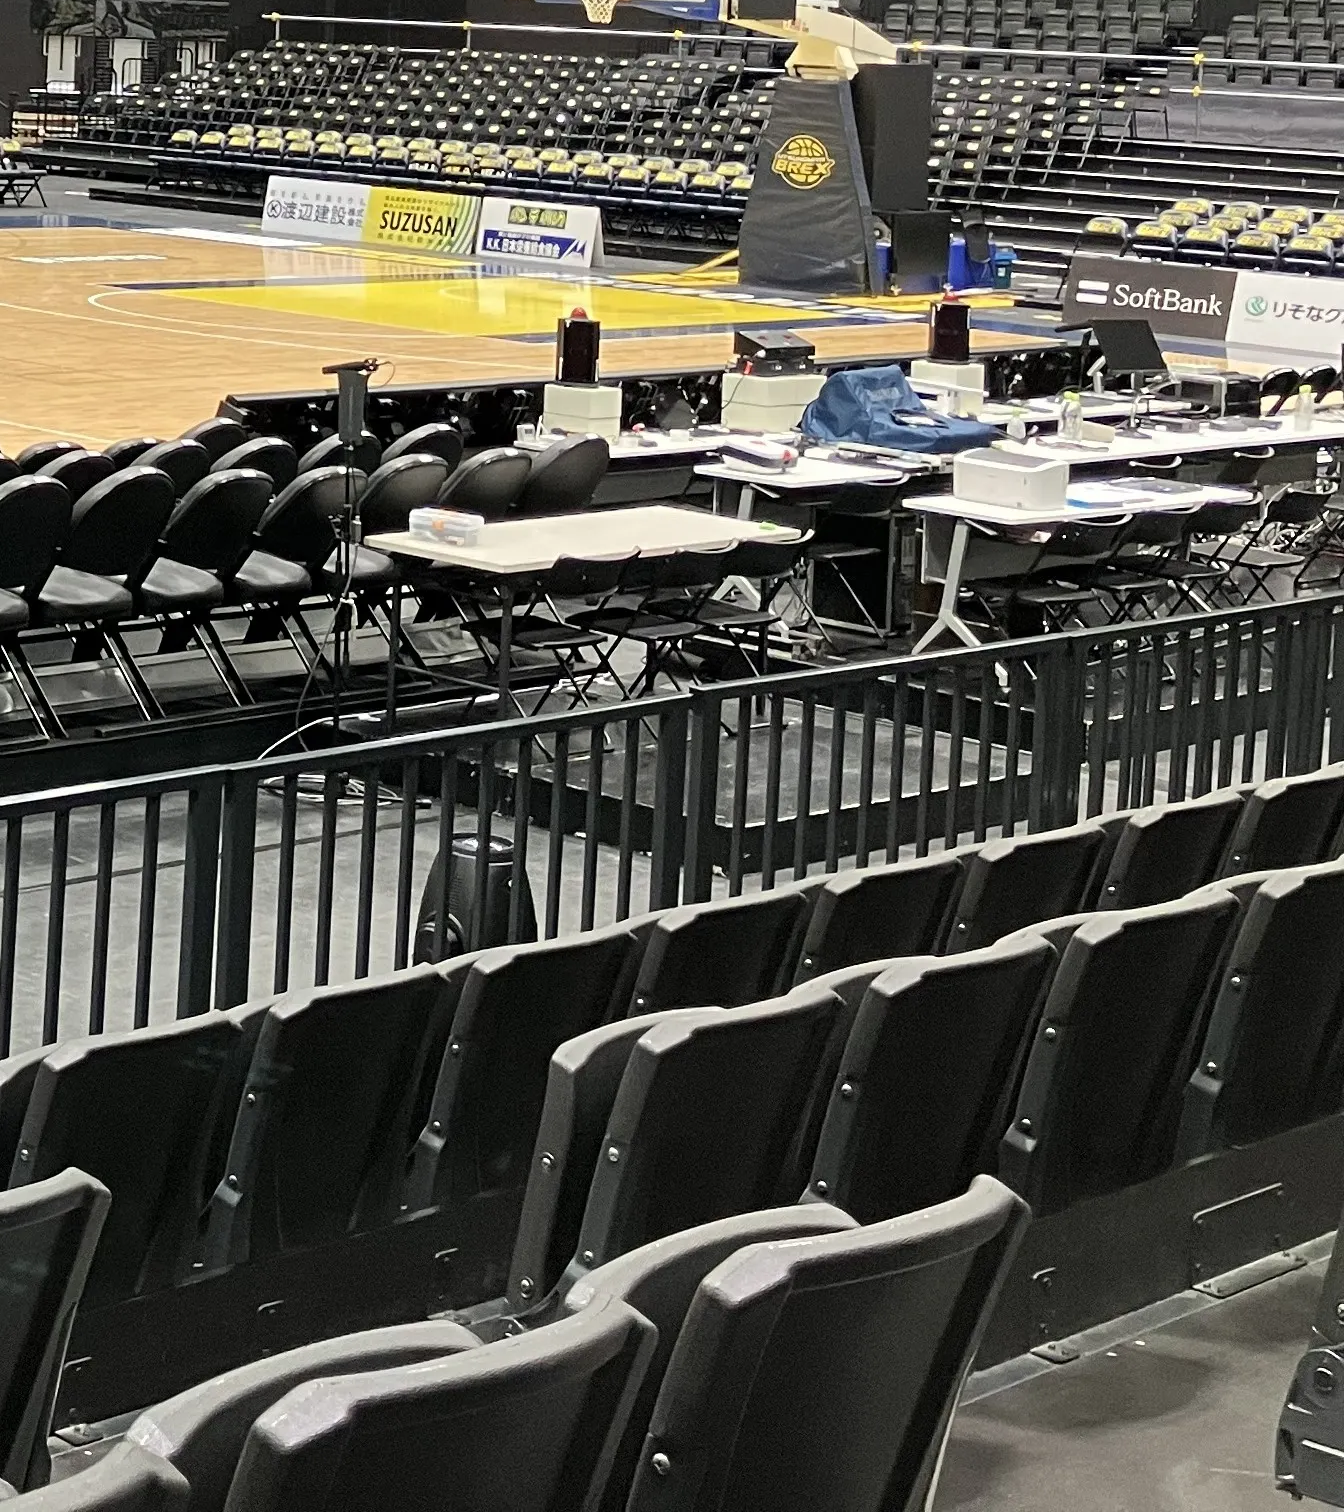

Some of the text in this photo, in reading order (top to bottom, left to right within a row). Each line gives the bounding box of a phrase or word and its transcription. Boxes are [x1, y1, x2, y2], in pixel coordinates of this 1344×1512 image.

[775, 159, 831, 175] BREX
[379, 210, 458, 238] SUZUSAN
[1113, 285, 1222, 316] SoftBank
[1273, 301, 1344, 324] りそなグ
